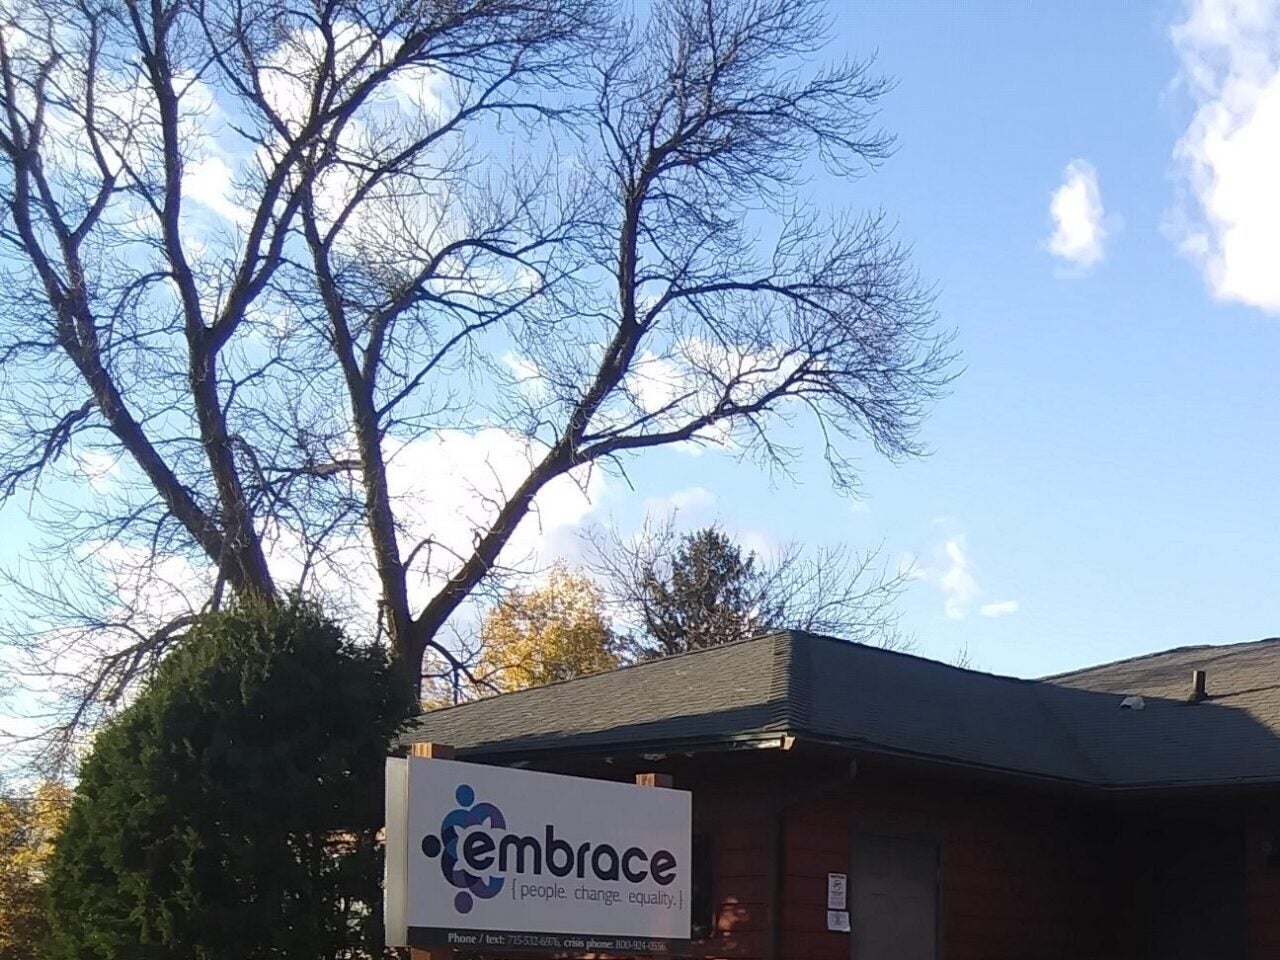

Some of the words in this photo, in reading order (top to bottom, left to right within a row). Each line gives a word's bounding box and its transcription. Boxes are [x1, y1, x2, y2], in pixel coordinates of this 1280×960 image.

[463, 824, 678, 886] embrace
[520, 882, 568, 901] people.
[574, 885, 623, 906] change.
[447, 932, 477, 944] Phone
[486, 934, 505, 945] text:
[563, 937, 584, 948] crisis
[586, 938, 614, 950] phone:
